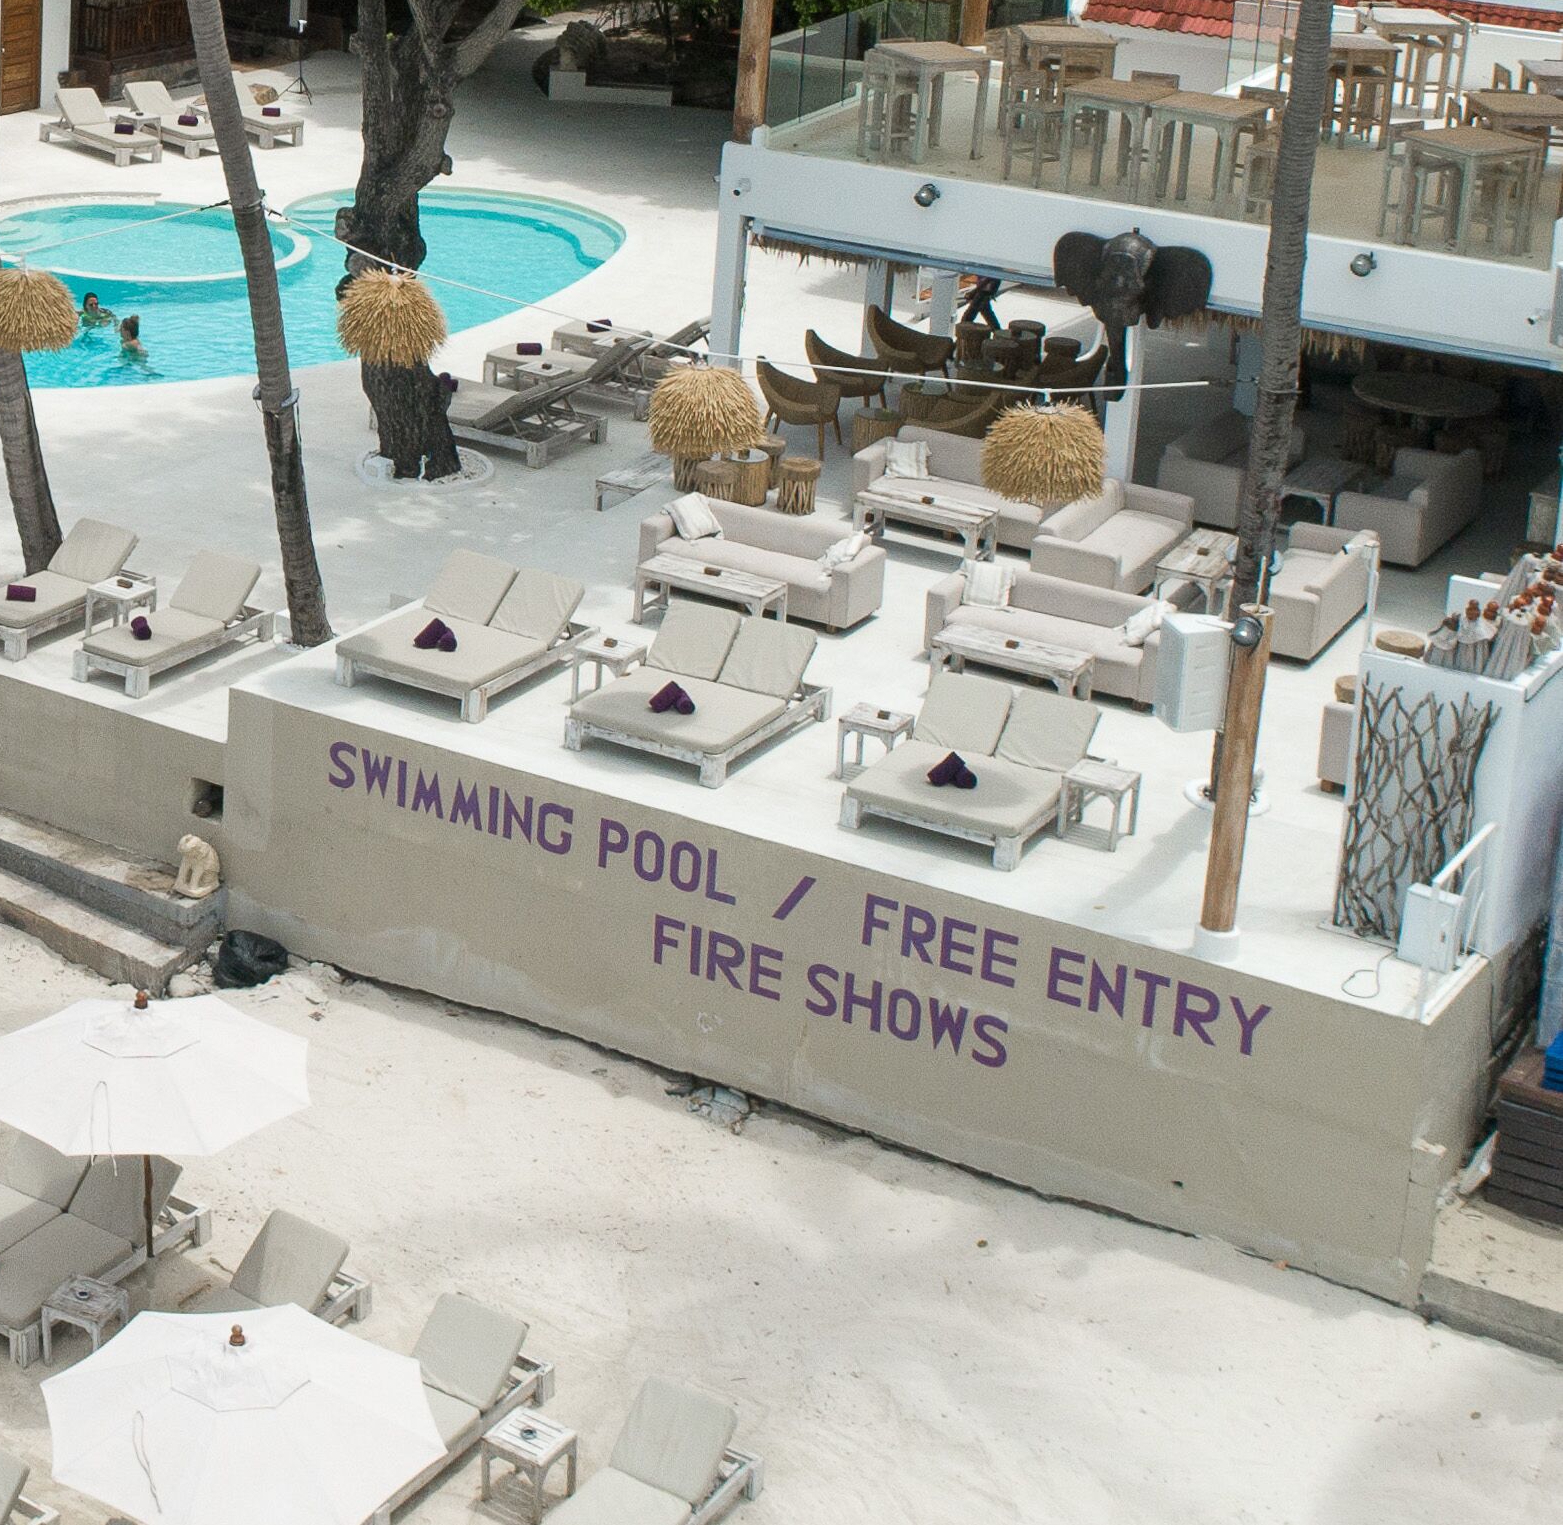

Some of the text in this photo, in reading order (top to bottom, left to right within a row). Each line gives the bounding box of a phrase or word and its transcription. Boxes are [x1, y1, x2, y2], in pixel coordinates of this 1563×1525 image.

[328, 741, 1271, 1056] SWIMMING POOL / FREE ENTRY
[653, 914, 1009, 1069] FIRE SHOWS
